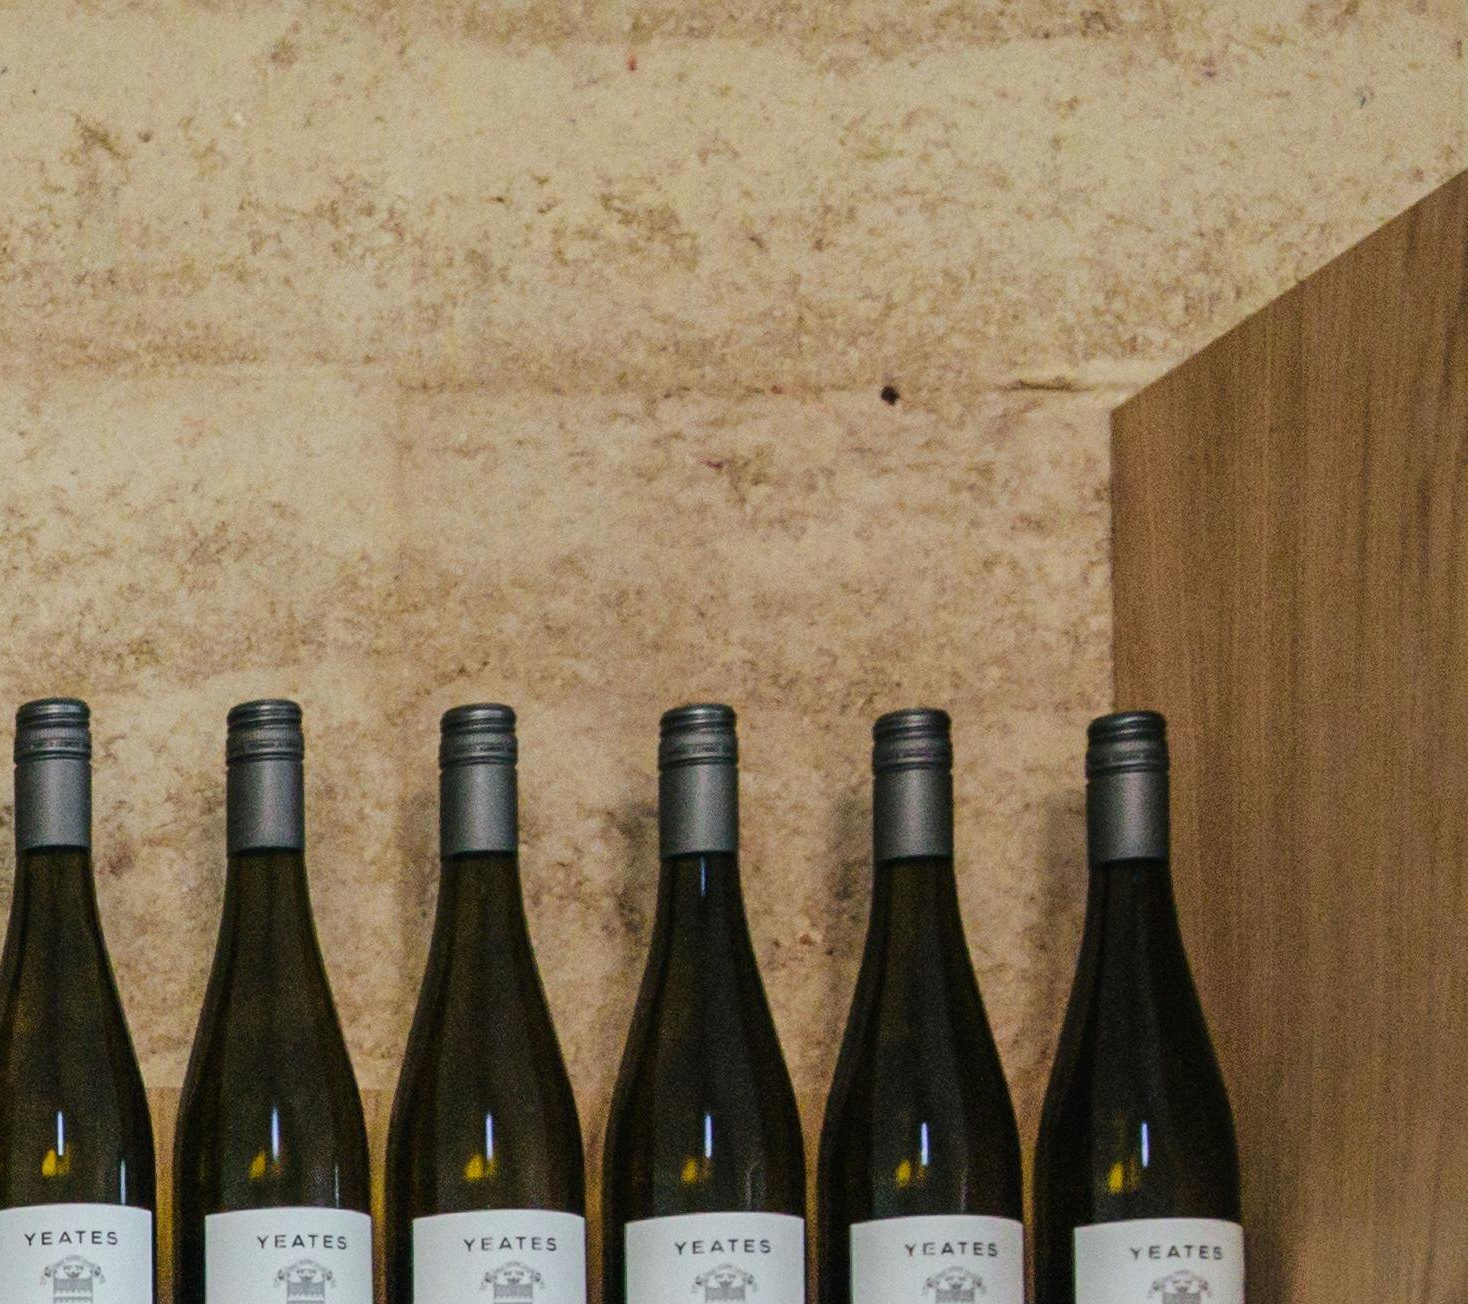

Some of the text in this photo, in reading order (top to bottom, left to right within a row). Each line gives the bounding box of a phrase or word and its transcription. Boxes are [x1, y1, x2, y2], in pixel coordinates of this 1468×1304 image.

[24, 1231, 118, 1246] YEATES
[257, 1234, 348, 1250] YEATES
[464, 1237, 558, 1252] YEATES
[675, 1239, 771, 1255] YEATES
[905, 1242, 998, 1257] YEATES
[1130, 1245, 1223, 1260] YEATES
